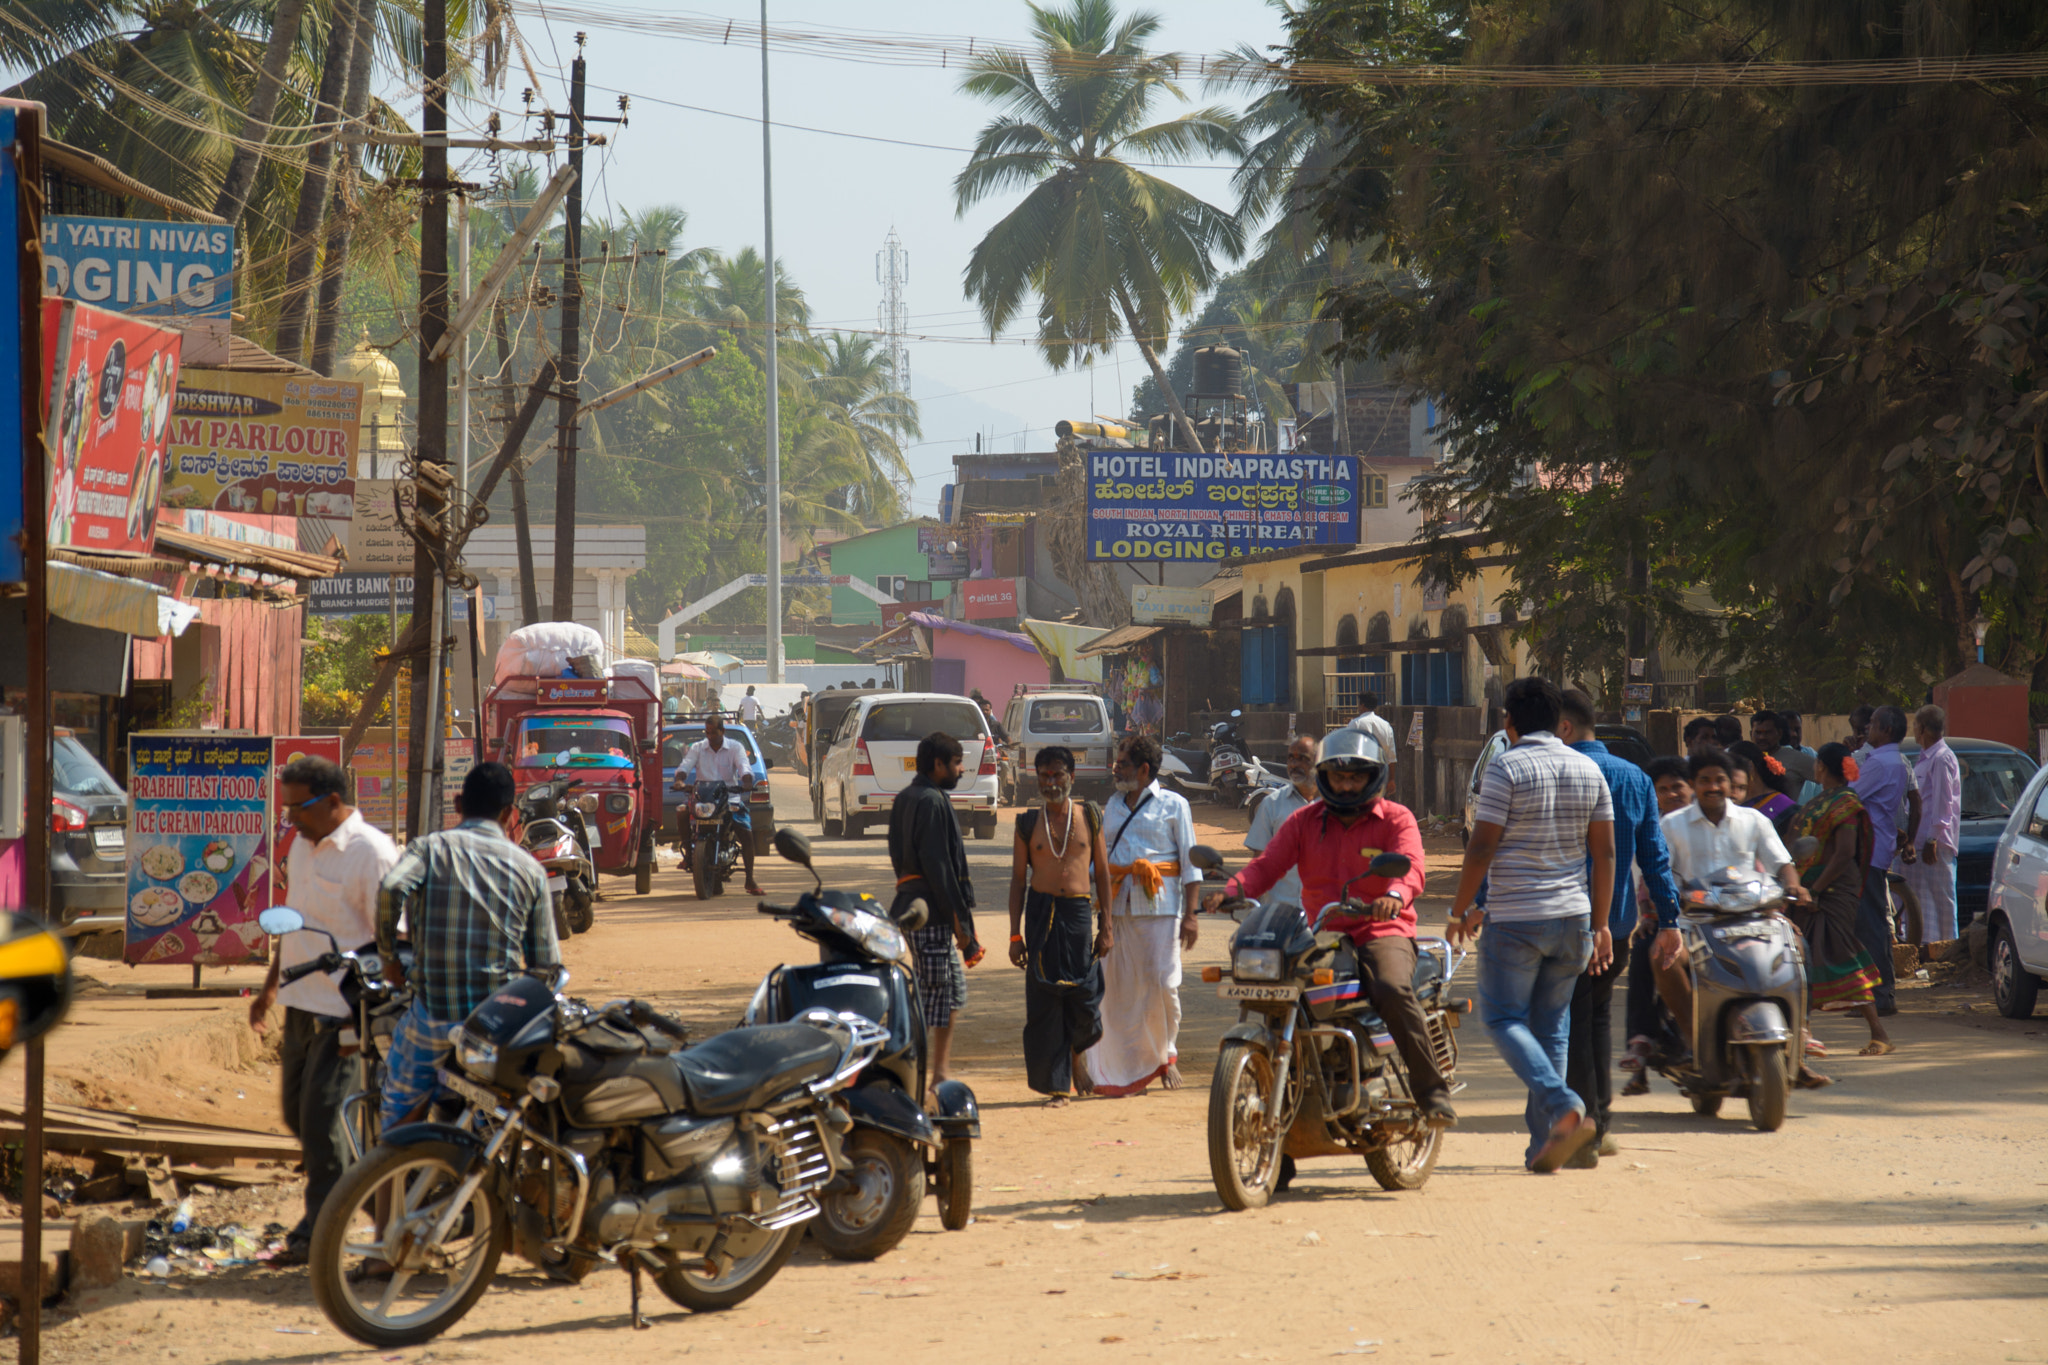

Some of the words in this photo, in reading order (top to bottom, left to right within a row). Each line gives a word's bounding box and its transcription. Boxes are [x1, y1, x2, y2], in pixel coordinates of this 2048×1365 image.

[67, 223, 140, 249] YATRI
[150, 228, 227, 254] NIVAS
[208, 420, 348, 458] PARLOUR
[1093, 456, 1168, 478] HOTEL
[1175, 457, 1351, 480] INDRAPRASTHA
[1094, 478, 1195, 500] ಹೋಟೆಲ್
[1093, 508, 1123, 519] SOUTH
[1158, 509, 1188, 520] NORTH
[1264, 511, 1293, 522] CHATS
[1294, 511, 1301, 521] &
[1318, 512, 1349, 523] CREAM
[1126, 523, 1204, 538] ROYAL
[1210, 524, 1318, 540] RETREAT
[1095, 540, 1226, 559] LODGING
[1230, 546, 1243, 557] &
[356, 577, 391, 593] BANK
[977, 593, 998, 603] airtel
[1001, 592, 1013, 601] 3G
[1135, 602, 1165, 612] TAXI
[1168, 604, 1210, 614] STAND
[132, 775, 186, 800] PRABHU
[187, 776, 219, 800] FAST
[220, 776, 257, 800] FOOD
[257, 776, 267, 800] &
[135, 811, 156, 834] ICE
[158, 810, 202, 834] CREAM
[204, 811, 263, 835] PARLOUR
